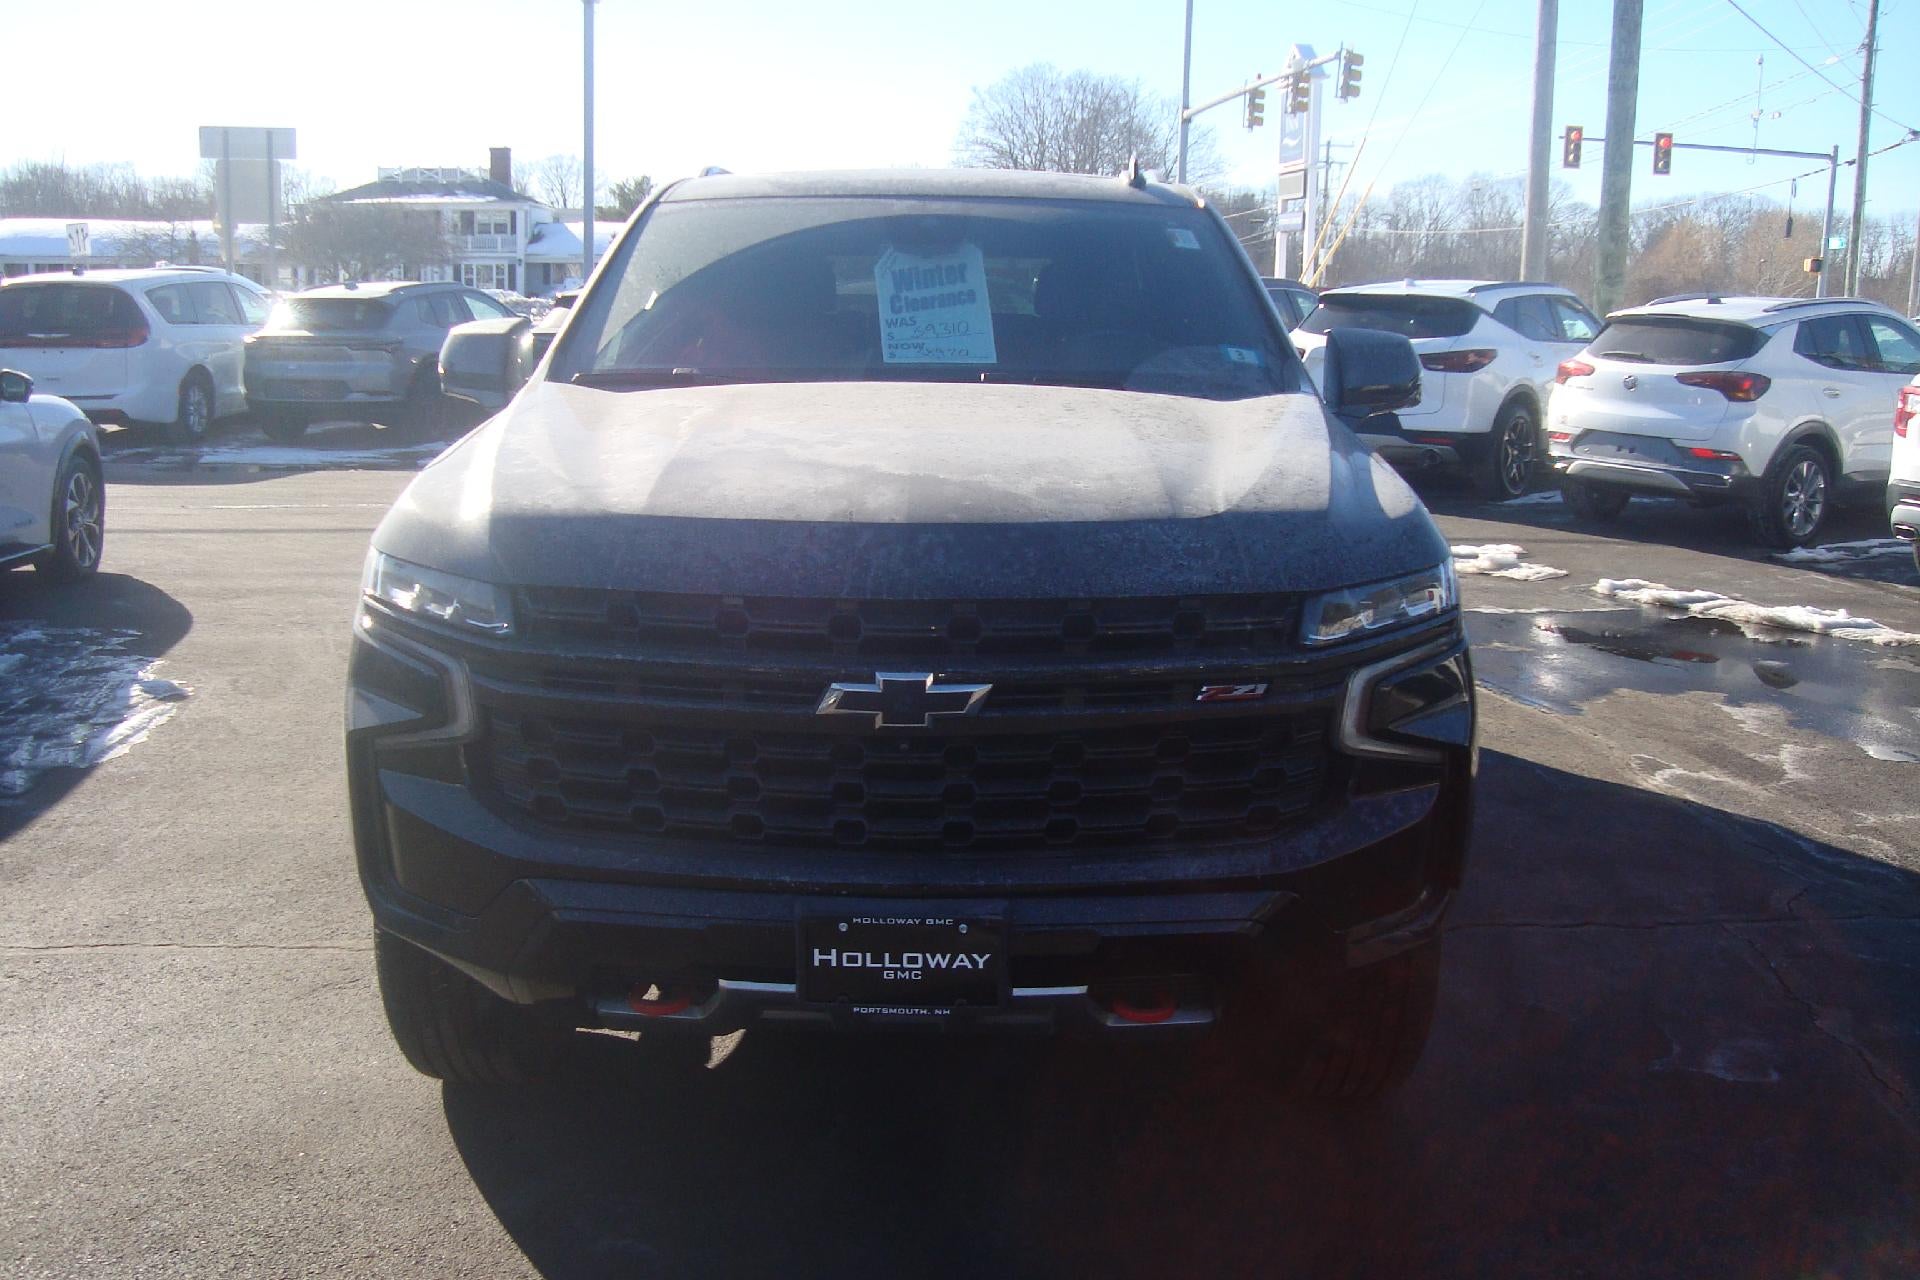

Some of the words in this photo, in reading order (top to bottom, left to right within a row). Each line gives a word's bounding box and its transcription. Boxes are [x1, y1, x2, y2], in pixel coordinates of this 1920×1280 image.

[891, 262, 968, 292] Winter
[1196, 683, 1268, 701] Z71
[852, 917, 922, 925] HOLLOWAY
[926, 918, 954, 926] GMC
[813, 948, 992, 969] HOLLOWAY
[883, 970, 922, 980] GMC
[934, 1008, 951, 1016] NH
